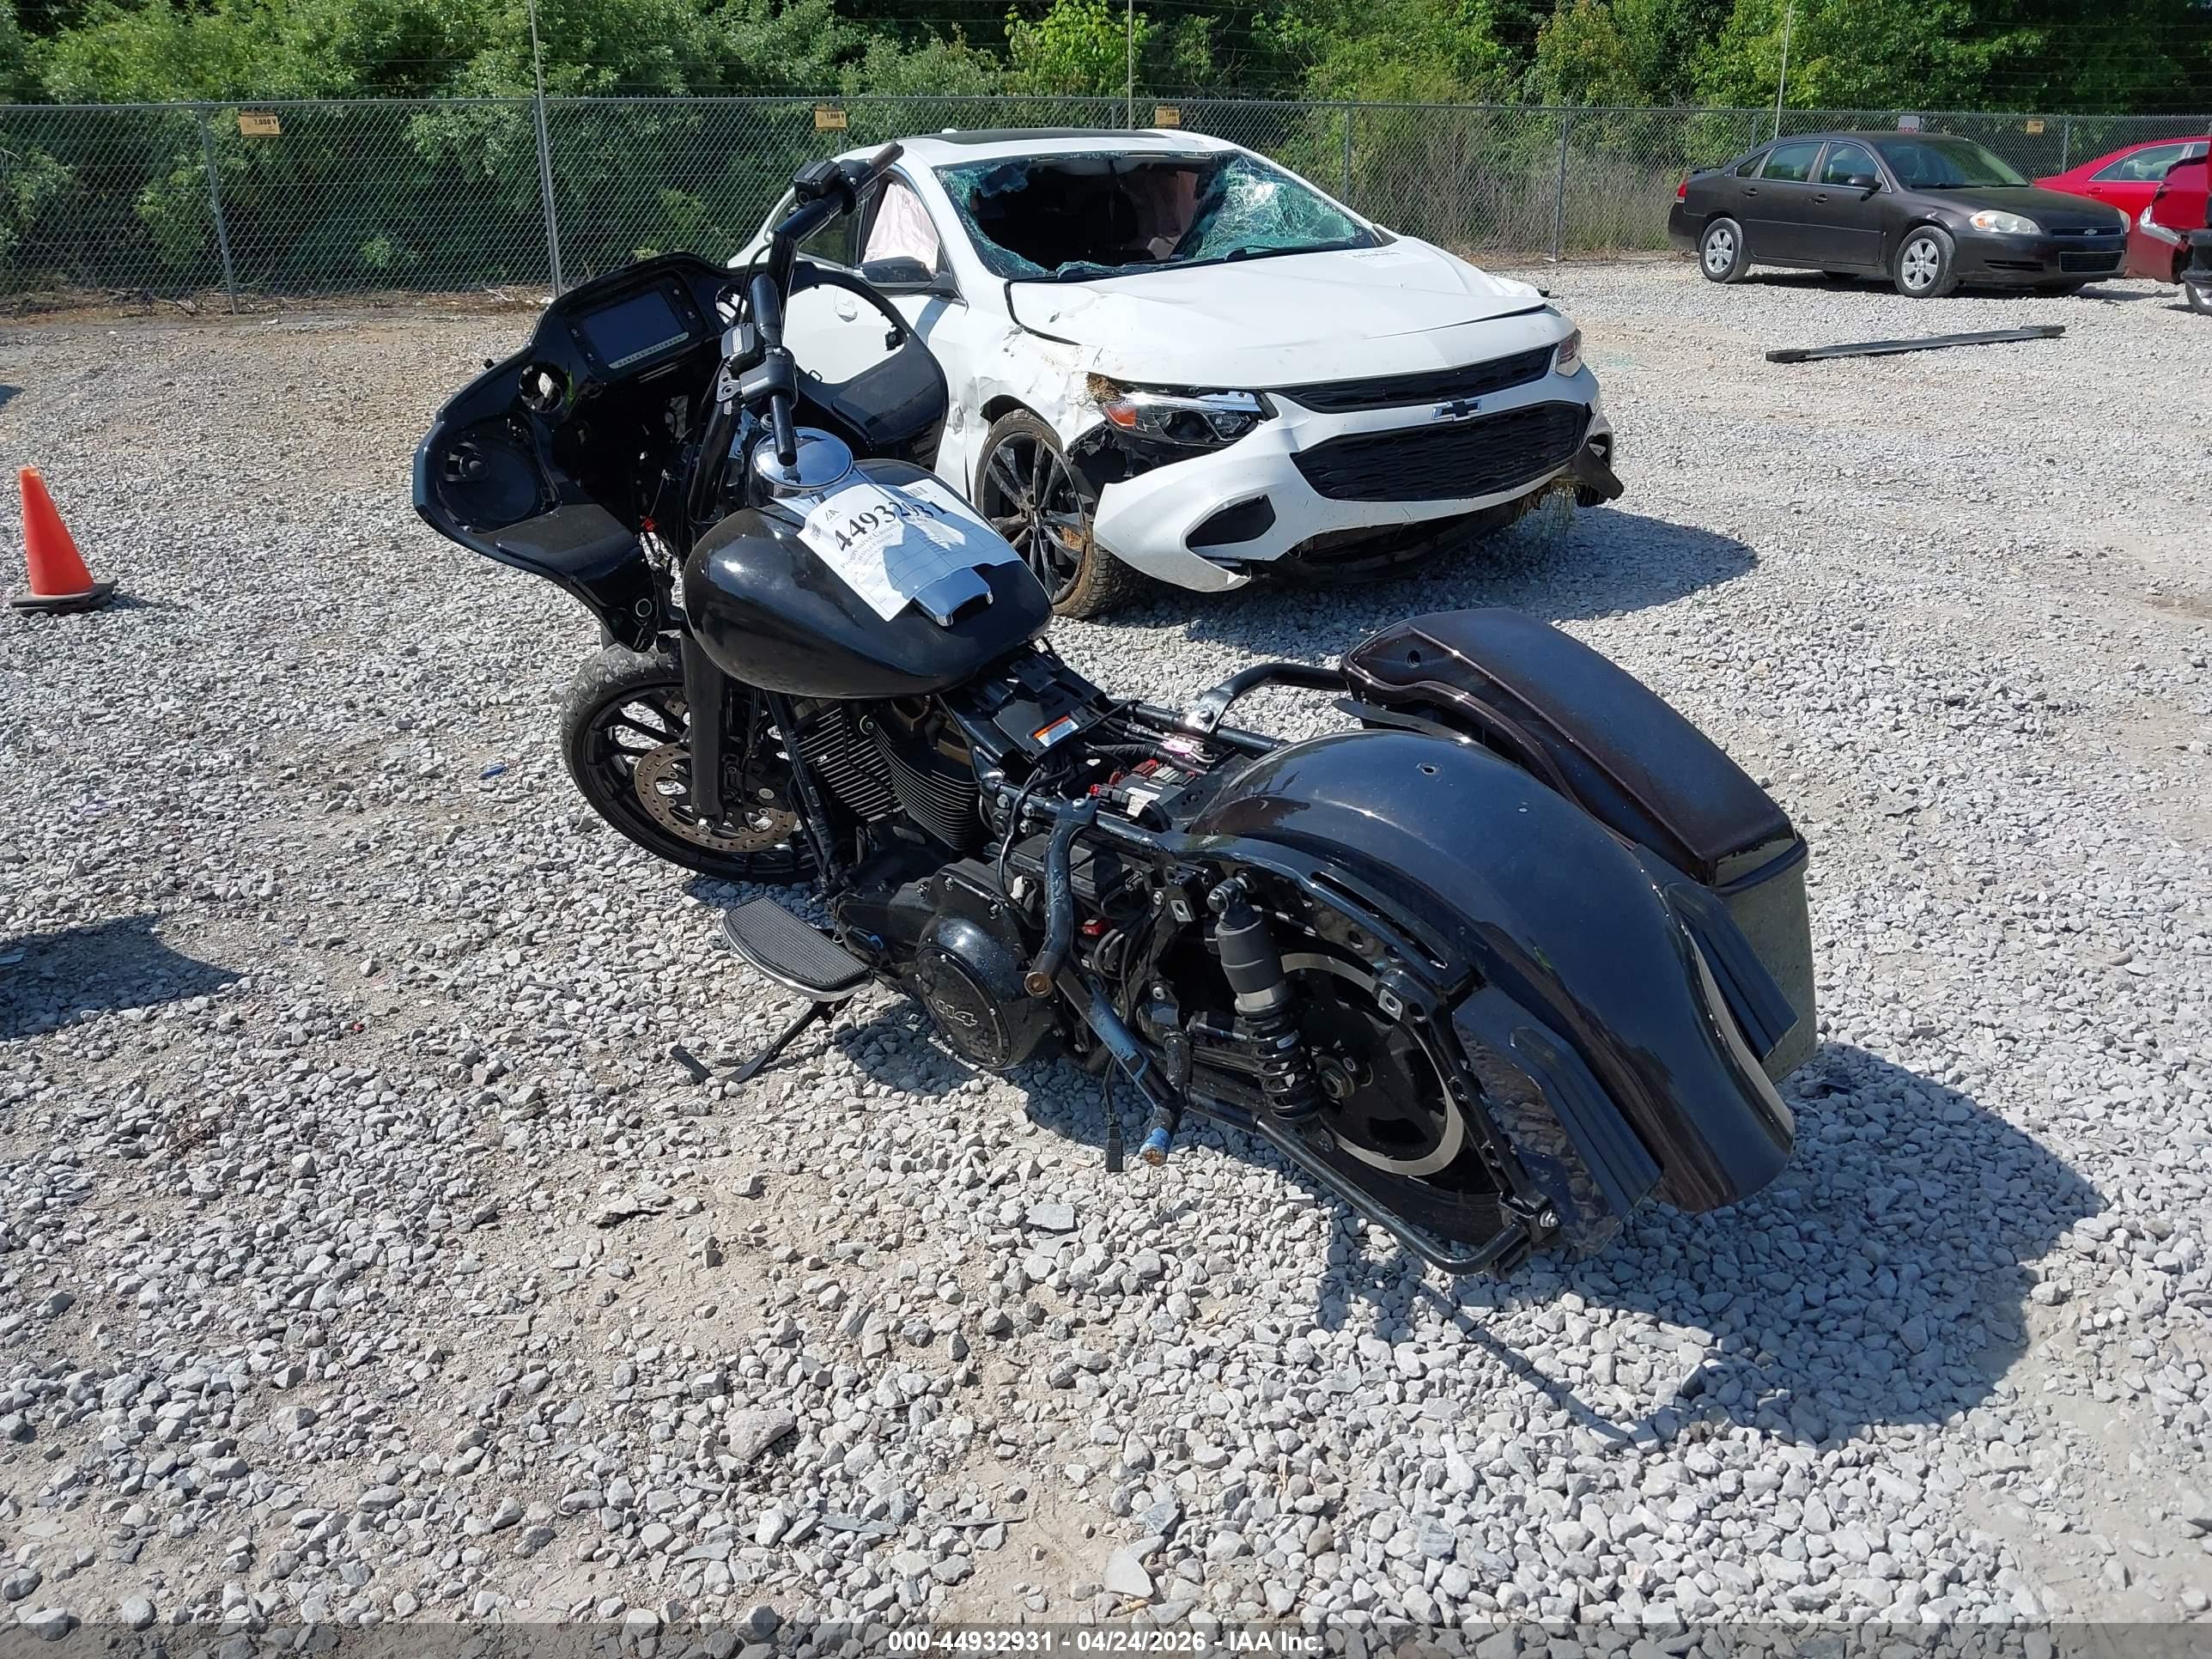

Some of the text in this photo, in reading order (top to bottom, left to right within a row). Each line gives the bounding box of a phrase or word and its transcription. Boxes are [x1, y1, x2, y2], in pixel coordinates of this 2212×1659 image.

[835, 501, 948, 552] 44932931
[840, 533, 874, 569] Progressive
[871, 520, 902, 538] Casualty
[936, 999, 979, 1028] 114
